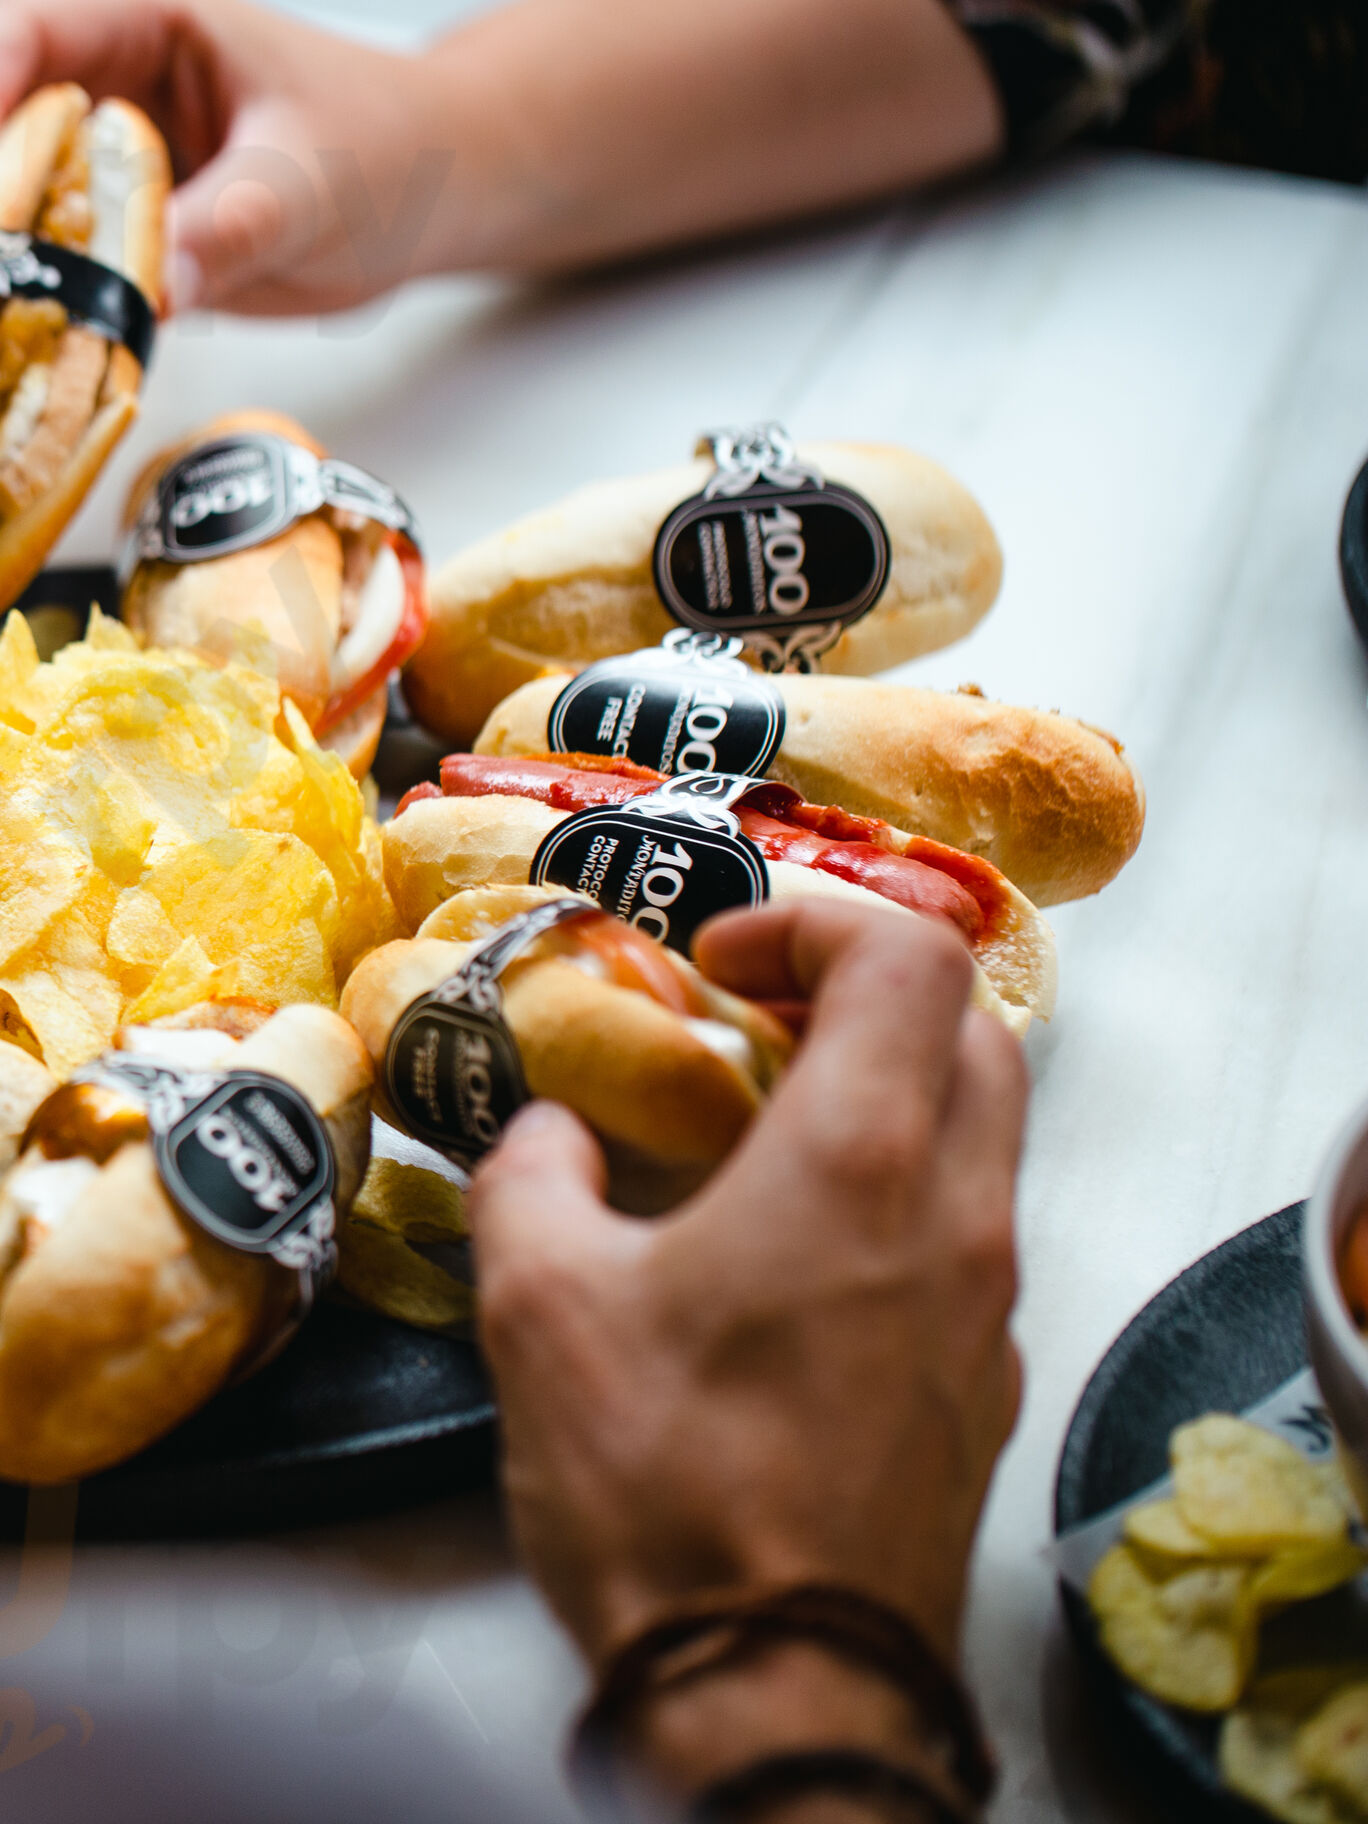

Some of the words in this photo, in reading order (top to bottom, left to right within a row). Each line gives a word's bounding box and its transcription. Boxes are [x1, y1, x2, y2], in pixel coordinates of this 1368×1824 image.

[759, 502, 810, 616] 100
[596, 696, 623, 742] FREE
[575, 834, 607, 894] CONTACT
[589, 837, 620, 901] PROTOCO
[615, 834, 662, 922] MONTADIT
[631, 842, 694, 943] 100
[194, 1112, 288, 1213] 100
